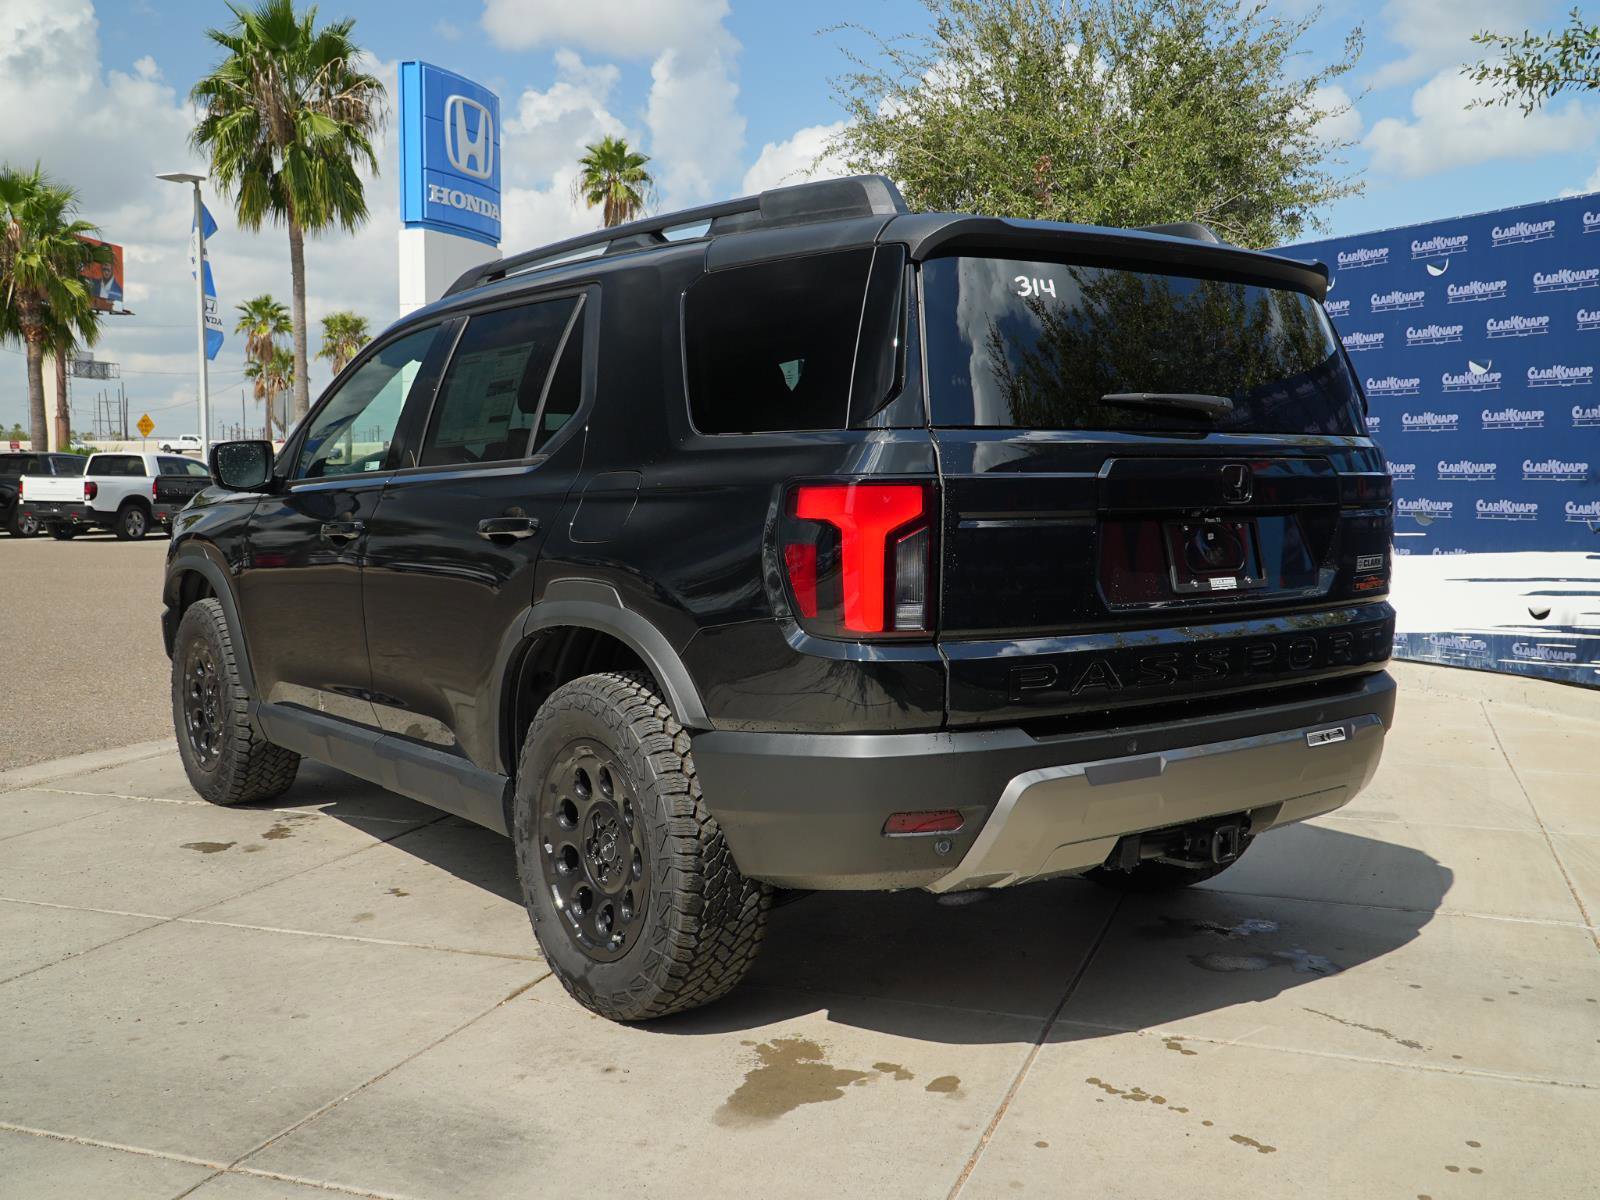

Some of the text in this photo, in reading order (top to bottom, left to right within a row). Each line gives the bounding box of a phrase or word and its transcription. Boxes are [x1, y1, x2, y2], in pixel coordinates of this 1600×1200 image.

[428, 184, 501, 223] HONDA
[1014, 275, 1057, 298] 314
[1008, 627, 1385, 701] PASSPORT
